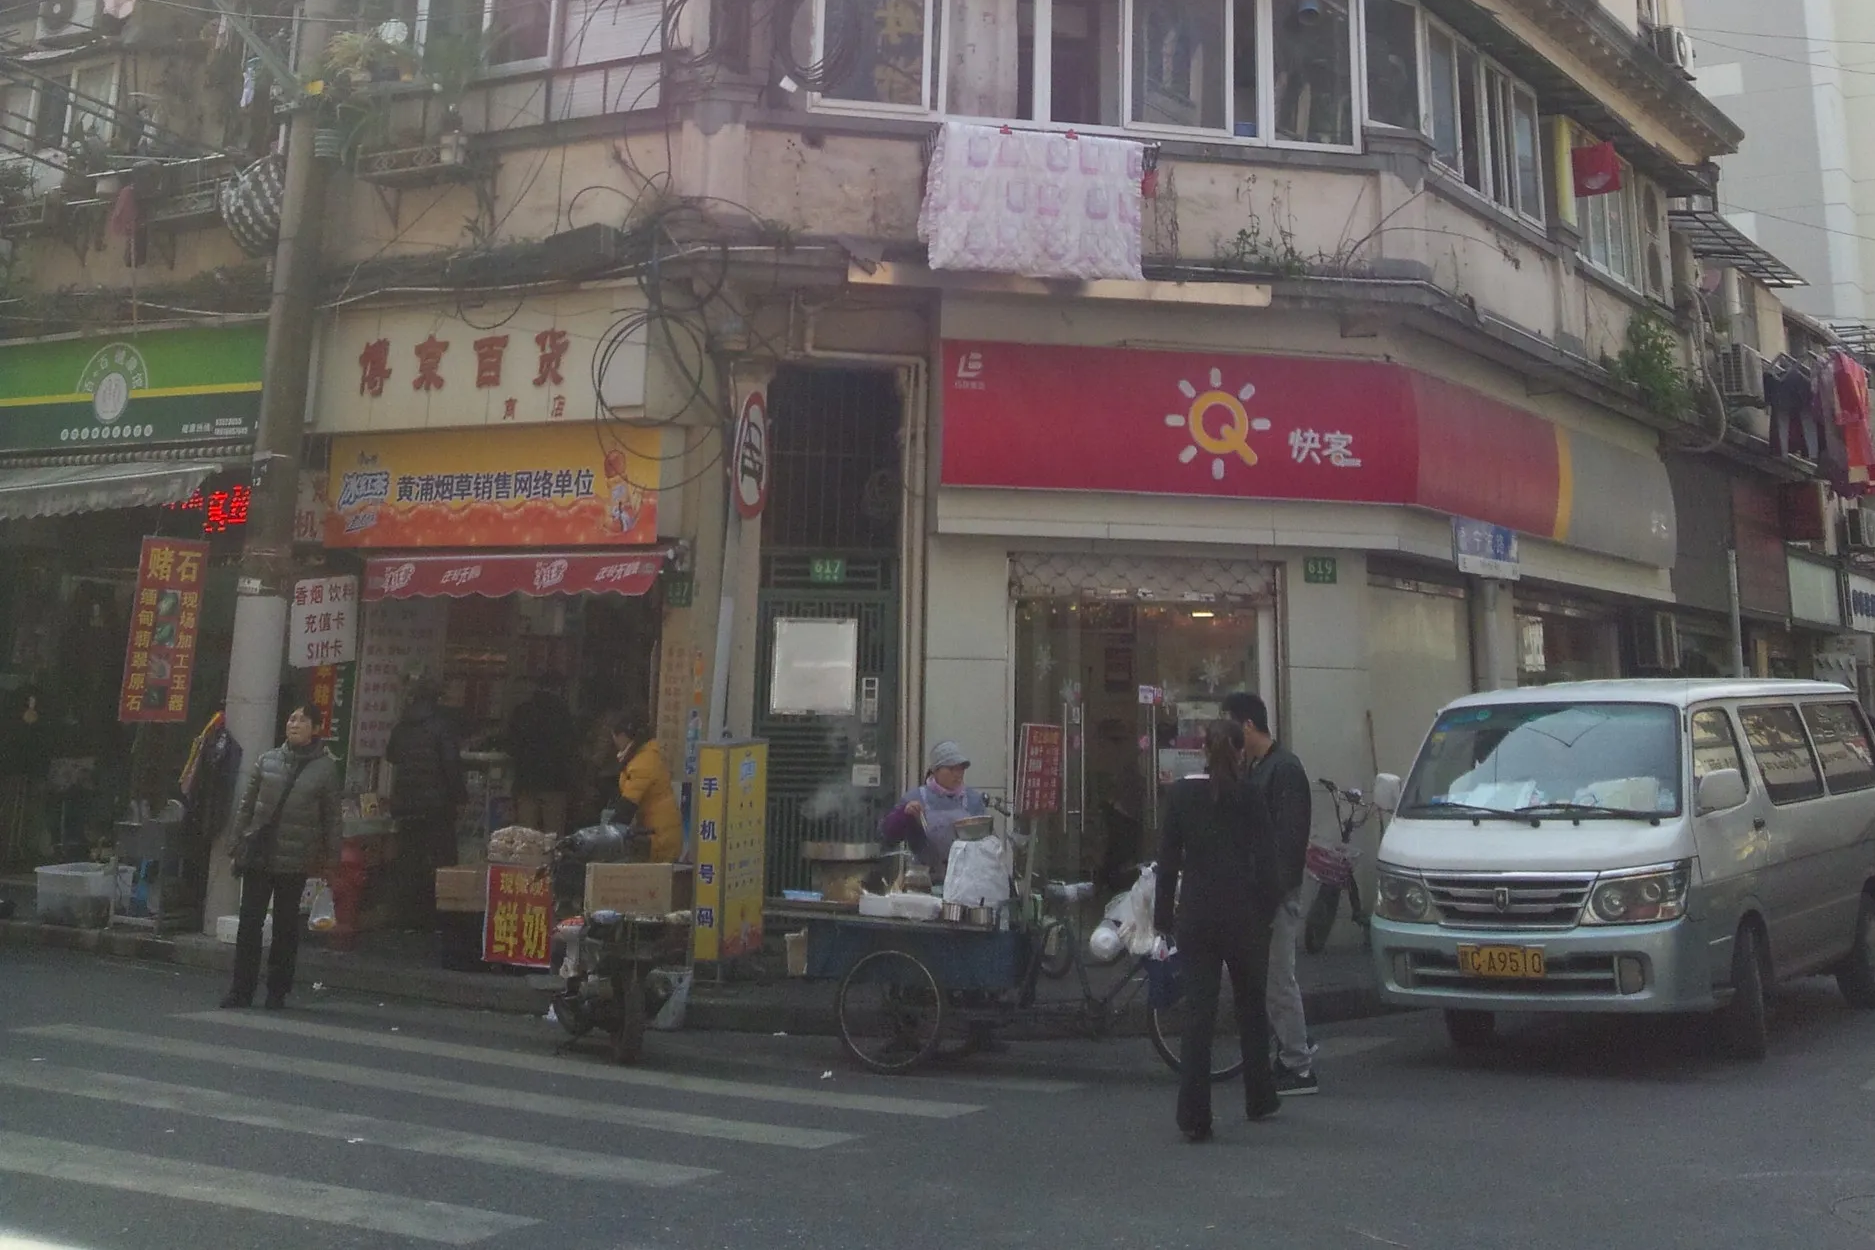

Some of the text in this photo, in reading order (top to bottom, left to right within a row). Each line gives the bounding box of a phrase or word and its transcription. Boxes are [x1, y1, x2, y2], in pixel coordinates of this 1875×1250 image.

[1287, 428, 1362, 468] 快客
[395, 469, 595, 502] 黄浦烟草销售网络单位
[146, 546, 203, 582] 赌石
[814, 559, 842, 574] 617
[1307, 558, 1333, 575] 619
[295, 582, 356, 606] 香烟 饮料
[304, 611, 346, 635] 充值卡
[167, 590, 199, 712] 现场加工玉器
[306, 639, 344, 661] SIM卡
[696, 776, 719, 929] 手机号码
[492, 900, 548, 959] 鲜奶
